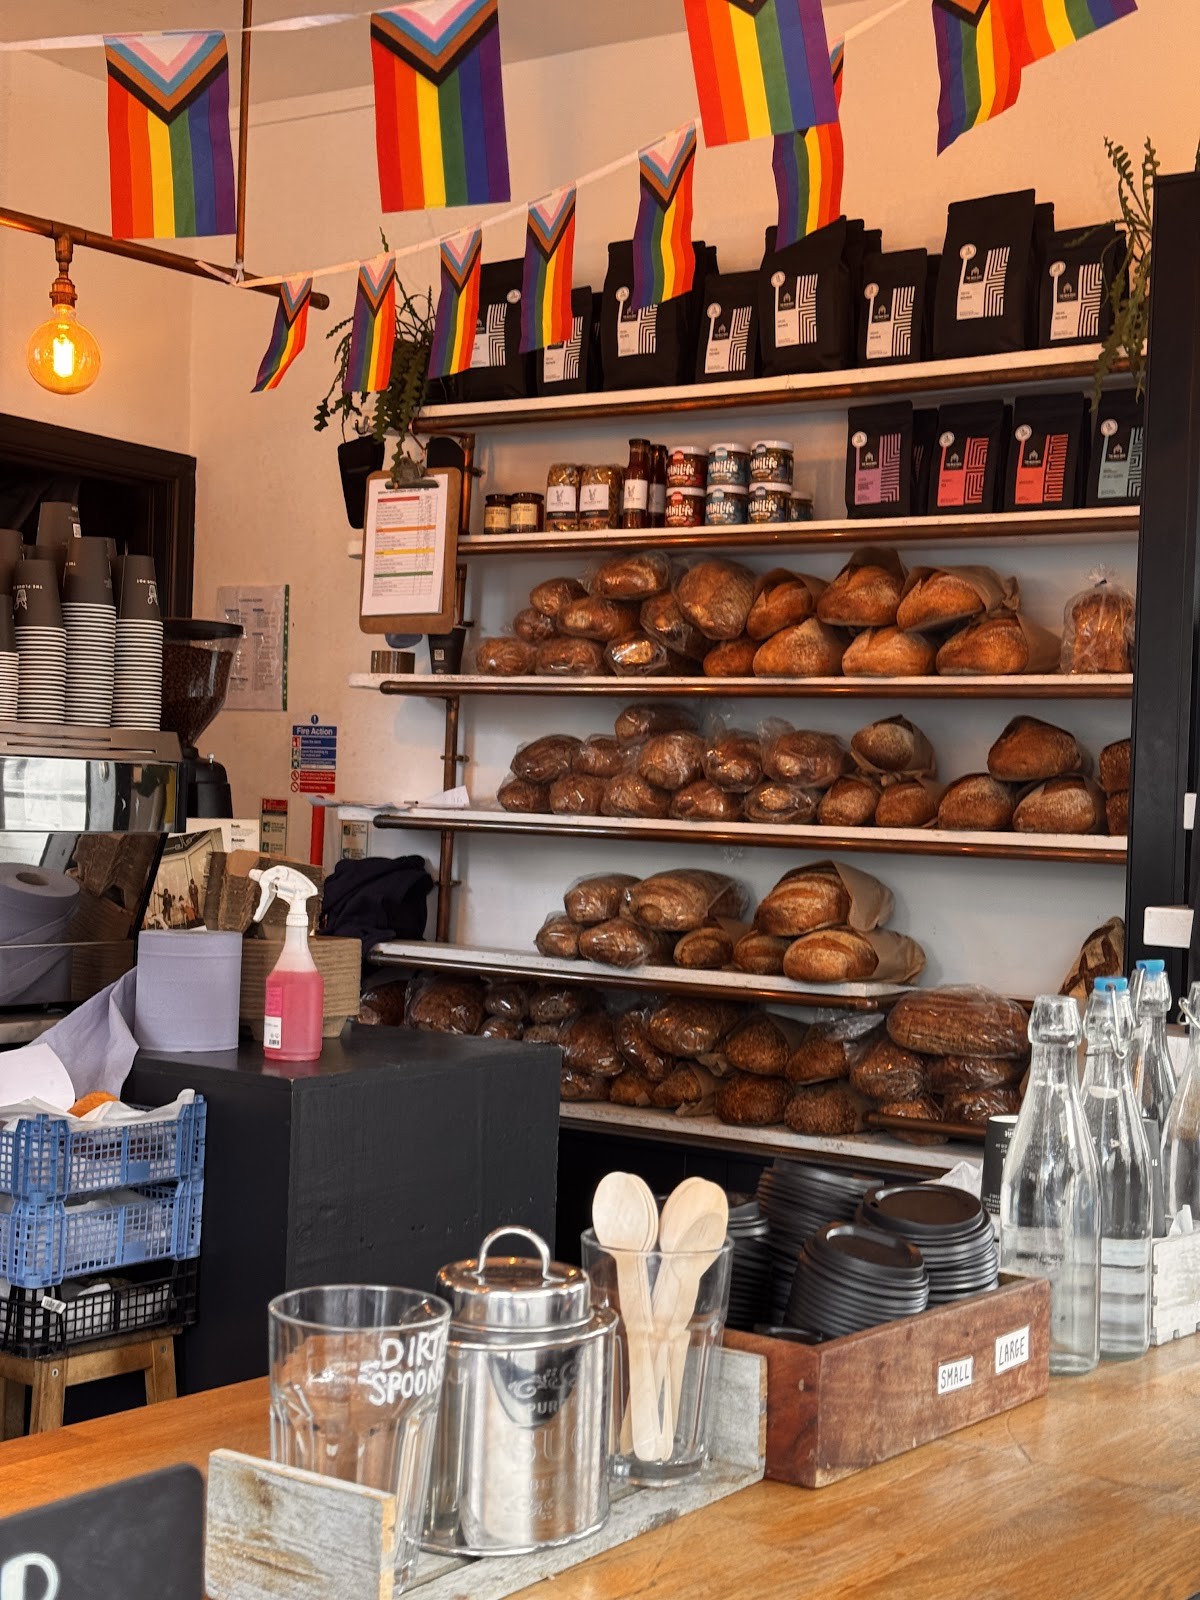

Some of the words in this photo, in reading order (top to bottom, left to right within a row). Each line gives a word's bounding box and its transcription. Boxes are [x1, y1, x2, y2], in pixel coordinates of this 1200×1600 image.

[296, 727, 310, 735] Fire
[311, 727, 333, 735] Action
[998, 1336, 1026, 1366] LARGE
[940, 1364, 970, 1389] SMALL
